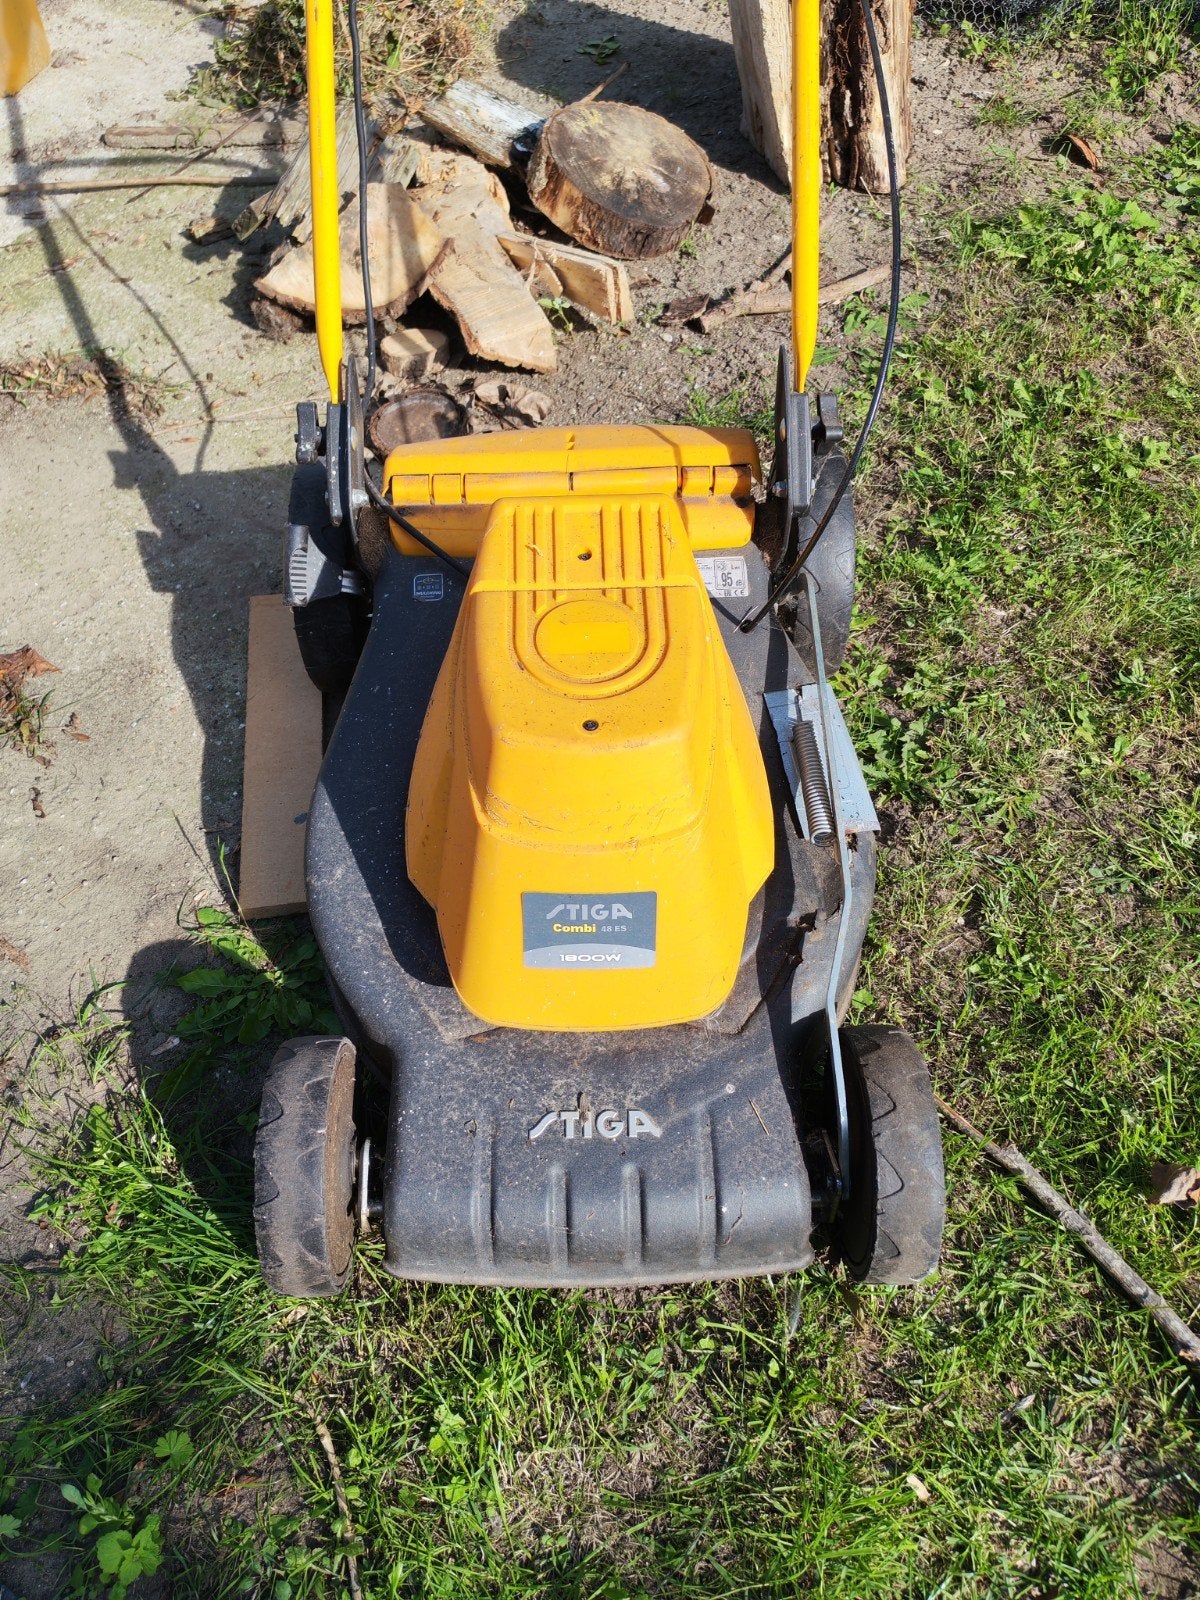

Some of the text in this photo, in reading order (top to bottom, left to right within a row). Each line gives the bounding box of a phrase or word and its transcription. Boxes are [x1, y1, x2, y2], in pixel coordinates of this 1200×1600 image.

[721, 572, 733, 587] 95
[546, 903, 633, 921] STIGA
[553, 923, 597, 933] Combi
[559, 953, 623, 962] 1800W
[528, 1110, 661, 1139] STIGA
